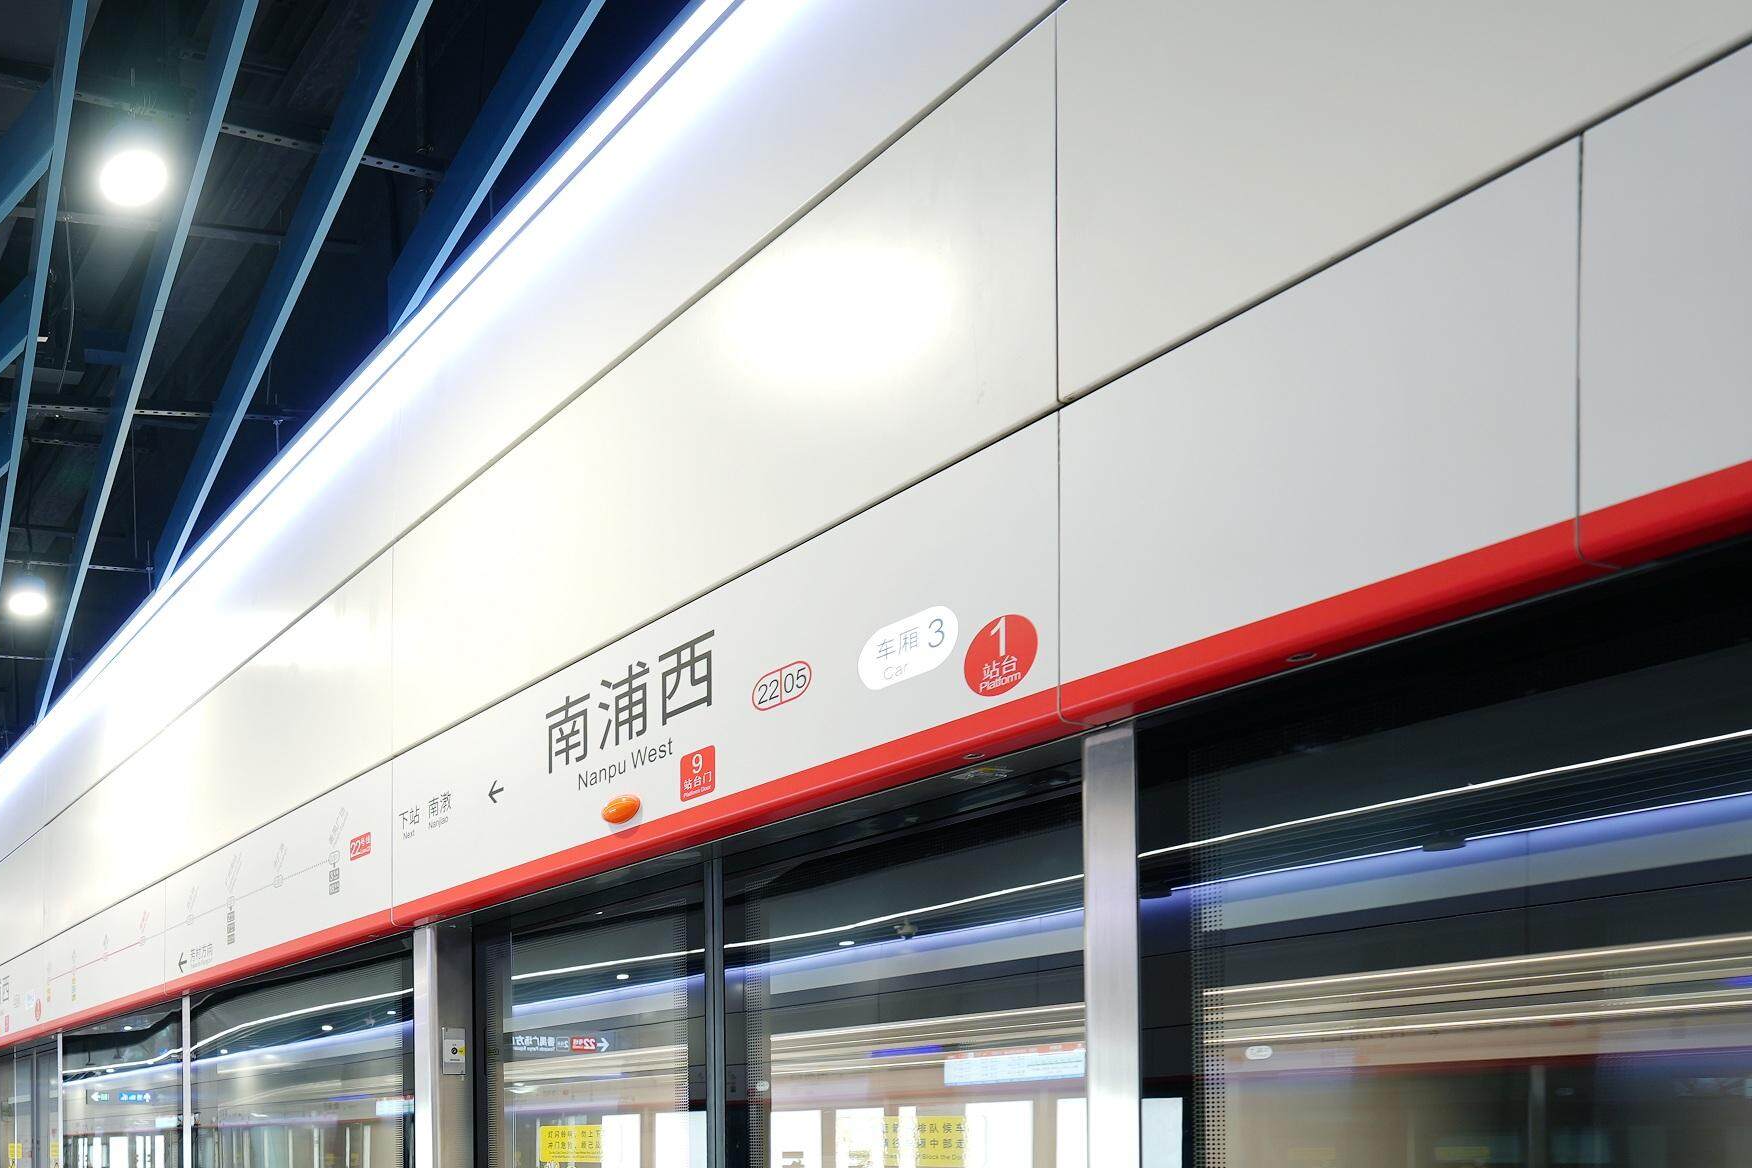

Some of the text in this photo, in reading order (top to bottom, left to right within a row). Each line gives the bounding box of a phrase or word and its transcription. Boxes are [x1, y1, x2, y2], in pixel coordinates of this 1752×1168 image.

[928, 618, 946, 648] 3
[989, 616, 1007, 656] 1
[982, 655, 1018, 681] 站台
[979, 670, 1022, 693] Platform
[545, 629, 715, 774] 南浦西
[577, 738, 673, 790] Nanpu West
[691, 753, 703, 774] 9
[683, 770, 712, 791] 站台门
[399, 805, 420, 830] 下站
[403, 830, 416, 840] Next
